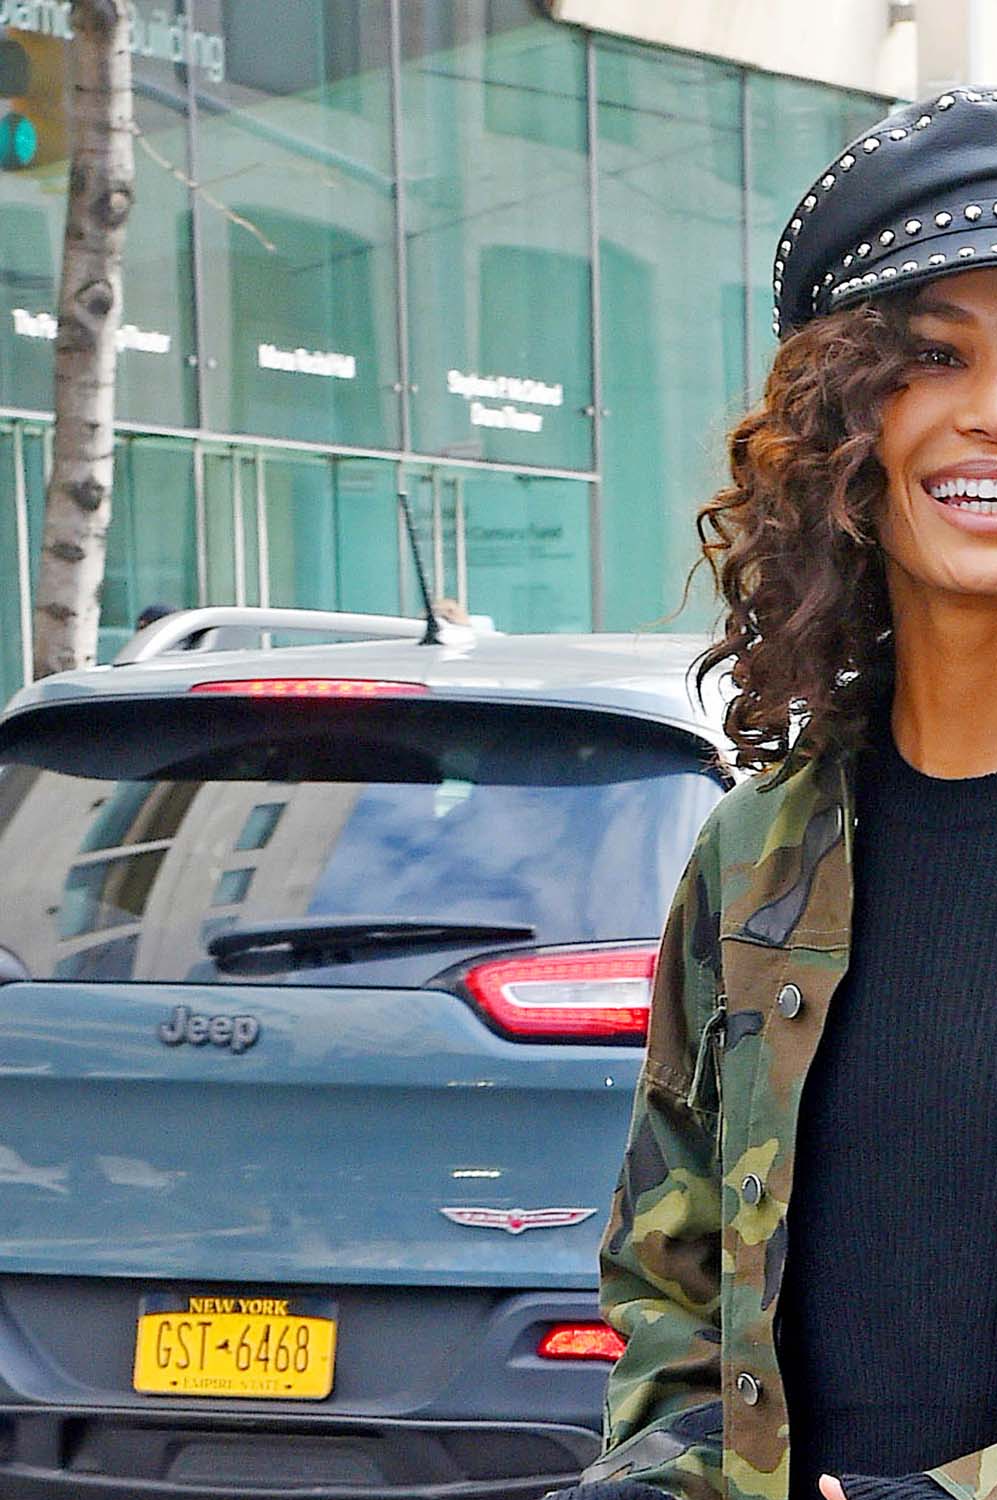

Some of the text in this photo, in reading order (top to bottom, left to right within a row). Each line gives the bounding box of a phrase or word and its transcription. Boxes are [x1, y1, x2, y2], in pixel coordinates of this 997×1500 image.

[160, 1004, 259, 1053] Jeep
[189, 1298, 288, 1316] NEW YORK
